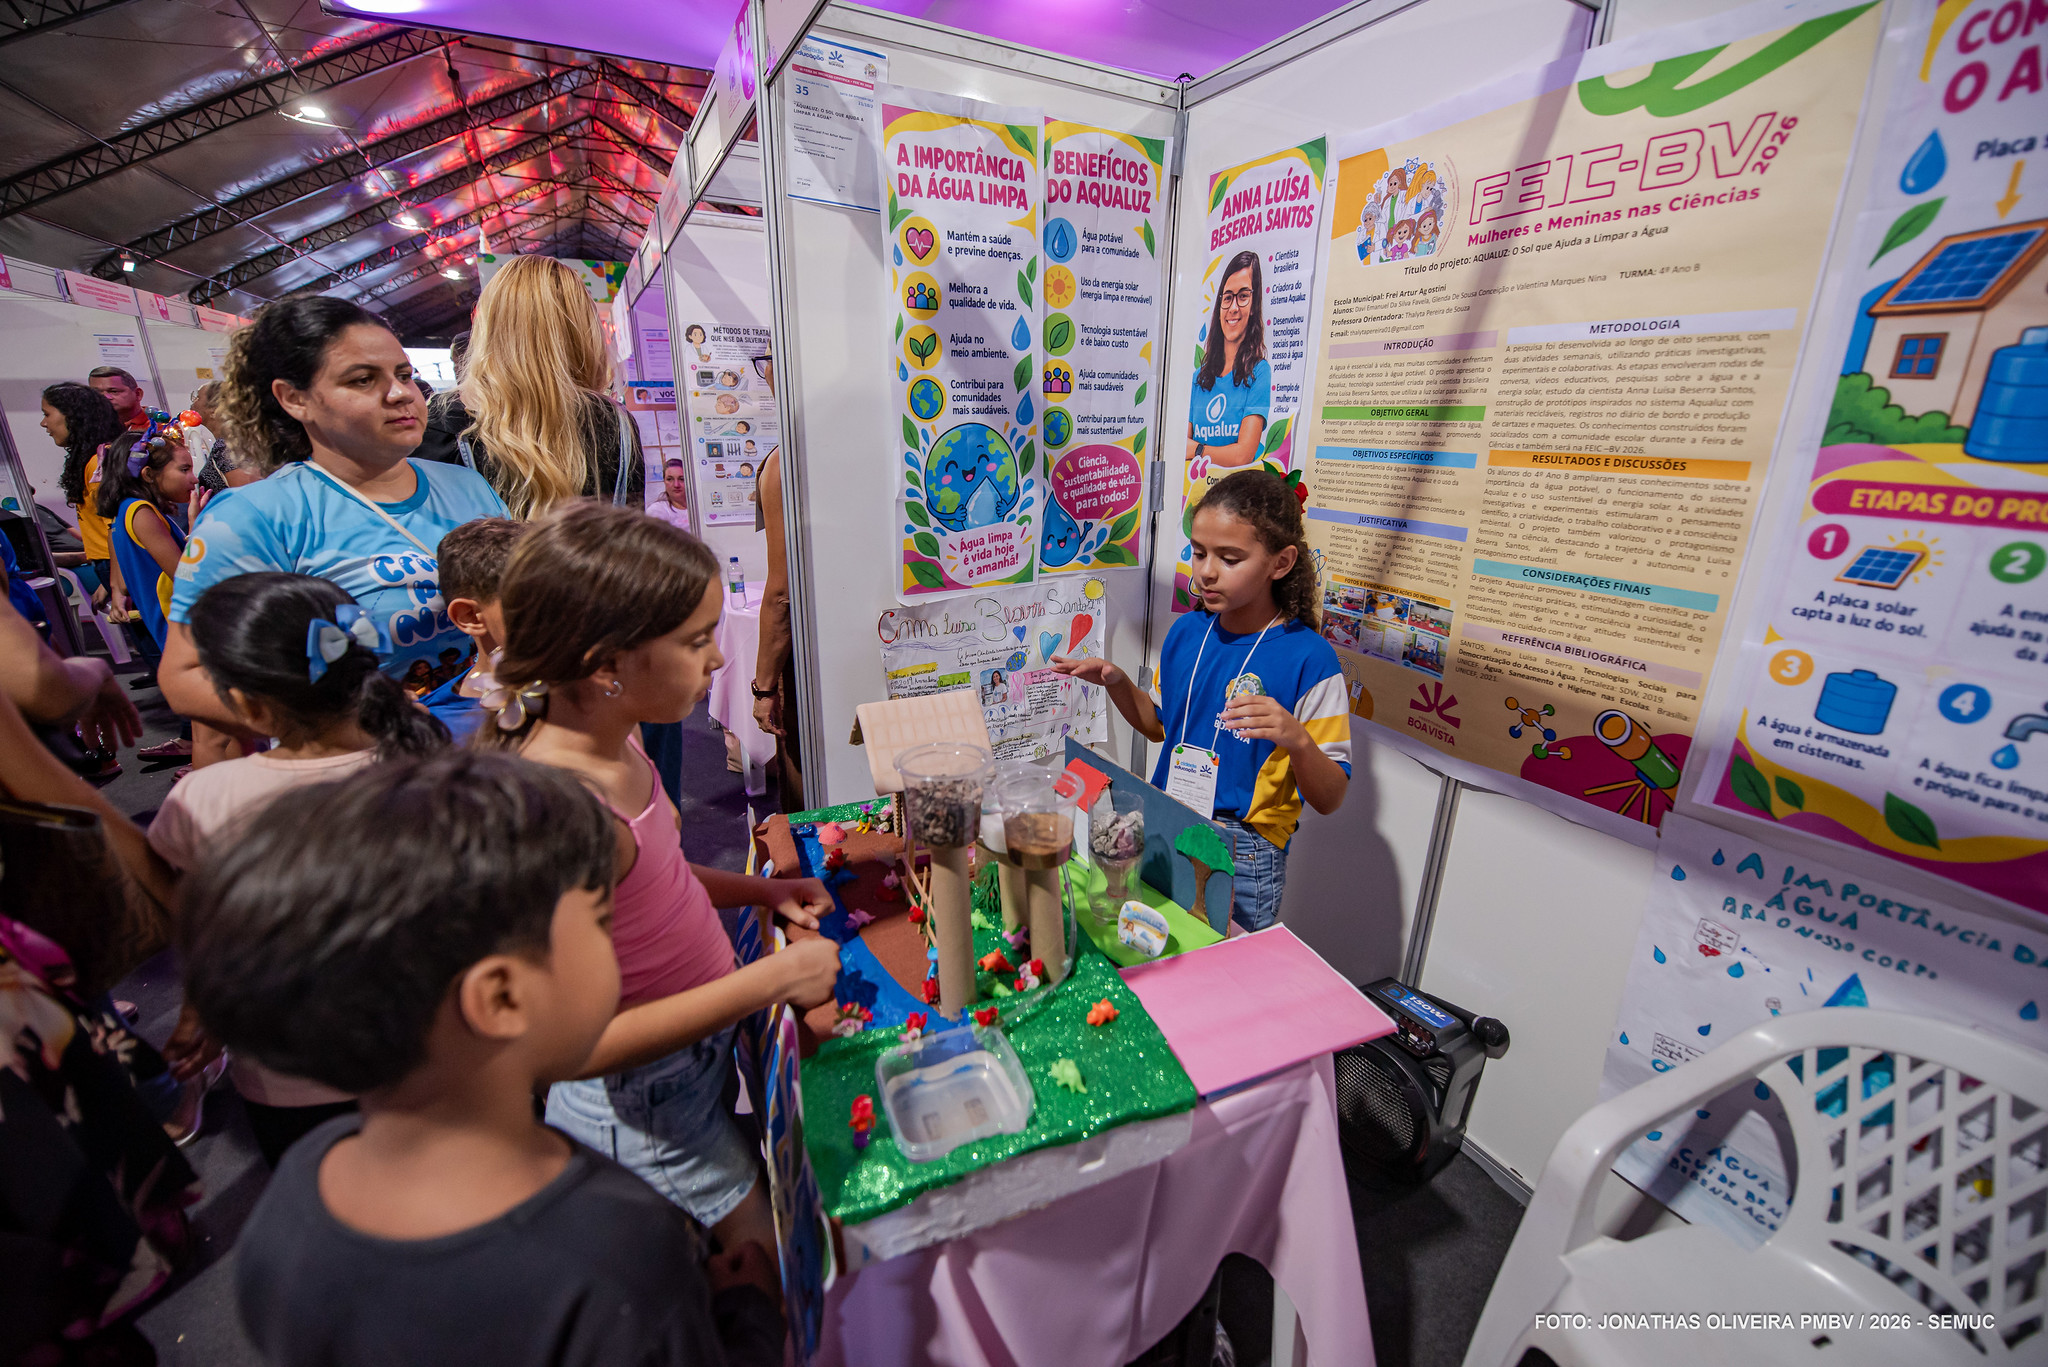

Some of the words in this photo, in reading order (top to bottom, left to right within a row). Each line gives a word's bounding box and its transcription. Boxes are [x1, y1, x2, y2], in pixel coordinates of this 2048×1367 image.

[795, 84, 809, 95] 35
[1943, 60, 1989, 114] O
[1752, 114, 1798, 176] 2026
[1973, 137, 2037, 162] Placa
[897, 143, 910, 166] A
[914, 145, 1025, 183] IMPORTÂNCIA
[1054, 149, 1148, 186] BENEFÍCIOS
[899, 173, 923, 198] DA
[927, 173, 974, 202] ÁGUA
[979, 183, 1028, 211] LIMPA
[1047, 179, 1072, 203] DO
[1076, 181, 1151, 213] AQUALUZ
[1222, 185, 1262, 221] ANNA
[1265, 167, 1309, 206] LUÍSA
[1211, 212, 1262, 251] BESERRA
[1265, 204, 1314, 232] SANTOS
[1467, 222, 1530, 248] Mulheres
[1533, 222, 1542, 234] e
[1547, 209, 1621, 232] Meninas
[1627, 203, 1661, 218] nas
[1668, 184, 1760, 213] Ciências
[947, 230, 980, 243] Mantém
[982, 235, 987, 243] a
[989, 232, 1012, 246] saúde
[1082, 227, 1098, 242] Água
[1099, 231, 1123, 246] potável
[955, 245, 986, 259] previne
[988, 248, 1023, 262] doenças.
[1082, 245, 1095, 255] para
[1102, 246, 1139, 259] comunidade
[1275, 251, 1299, 261] Cientista
[1404, 263, 1427, 276] Título
[1430, 262, 1438, 272] do
[1440, 256, 1471, 271] projeto:
[1473, 248, 1511, 263] AQUALUZ:
[1512, 246, 1518, 255] O
[1521, 243, 1534, 254] Sol
[1536, 242, 1552, 253] que
[1555, 237, 1582, 251] Ajuda
[1593, 231, 1629, 246] Limpar
[1641, 225, 1669, 239] Água
[1274, 261, 1299, 273] brasileira
[949, 282, 981, 295] Melhora
[983, 287, 988, 295] a
[1334, 297, 1351, 306] Escola
[1353, 290, 1384, 304] Municipal:
[1386, 289, 1398, 298] Frei
[1400, 287, 1418, 297] Artur
[1420, 284, 1446, 297] Agostini
[949, 297, 986, 310] qualidade
[987, 298, 997, 309] de
[998, 299, 1017, 311] vida.
[713, 326, 741, 334] MÉTODOS
[1331, 316, 1362, 327] Professora
[1364, 312, 1404, 324] Orientadora:
[1589, 320, 1681, 335] METODOLOGIA
[950, 334, 972, 346] Ajuda
[975, 335, 984, 344] no
[1383, 340, 1434, 350] INTRODUÇÃO
[951, 348, 969, 358] meio
[972, 348, 1009, 359] ambiente.
[951, 379, 985, 391] Contribui
[987, 381, 1004, 391] para
[952, 392, 1001, 402] comunidades
[953, 406, 969, 415] mais
[972, 404, 1010, 415] saudáveis.
[1370, 408, 1404, 418] OBJETIVO
[1405, 408, 1429, 417] GERAL
[1194, 424, 1239, 441] Aqualuz
[1078, 453, 1109, 469] Ciência,
[1352, 450, 1388, 459] OBJETIVOS
[1390, 451, 1434, 461] ESPECÍFICOS
[1532, 454, 1601, 467] RESULTADOS
[1604, 458, 1610, 467] E
[1613, 458, 1687, 471] DISCUSSÕES
[1062, 491, 1069, 500] e
[1070, 480, 1107, 500] qualidade
[1108, 477, 1118, 489] de
[1119, 473, 1136, 487] vida
[1063, 463, 1130, 488] sustentabilidade
[1076, 497, 1098, 514] para
[1100, 487, 1129, 505] todos!
[1850, 488, 1946, 515] ETAPAS
[1951, 494, 1996, 519] DO
[1358, 516, 1407, 529] JUSTIFICATIVA
[960, 538, 985, 554] Água
[988, 530, 1012, 545] limpa
[1822, 530, 1838, 552] 1
[964, 554, 969, 566] é
[971, 549, 992, 563] vida
[994, 544, 1015, 560] hoje
[976, 554, 1019, 576] amanhã!
[2003, 549, 2032, 574] 2
[1522, 568, 1611, 590] CONSIDERAÇÕES
[1613, 582, 1651, 596] FINAIS
[1815, 591, 1828, 602] A
[1829, 592, 1869, 612] placa
[1875, 600, 1917, 617] solar
[1792, 605, 1833, 623] capta
[1836, 612, 1846, 623] a
[1850, 611, 1871, 629] luz
[1874, 617, 1894, 632] do
[1898, 621, 1928, 638] sol.
[1501, 632, 1563, 653] REFERÊNCIA
[1565, 646, 1647, 672] BIBLIOGRÁFICA
[1780, 655, 1802, 678] 3
[1952, 691, 1976, 716] 4
[1758, 715, 1768, 727] A
[1771, 718, 1802, 736] água
[1804, 725, 1812, 738] é
[1815, 729, 1889, 758] armazenada
[1773, 737, 1794, 749] em
[1798, 742, 1865, 770] cisternas.
[1736, 853, 1764, 879] A
[1722, 897, 1767, 922] PARA
[1776, 917, 1791, 928] O
[1765, 887, 1858, 930] ÁGUA
[1706, 1145, 1770, 1191] ÁGUA
